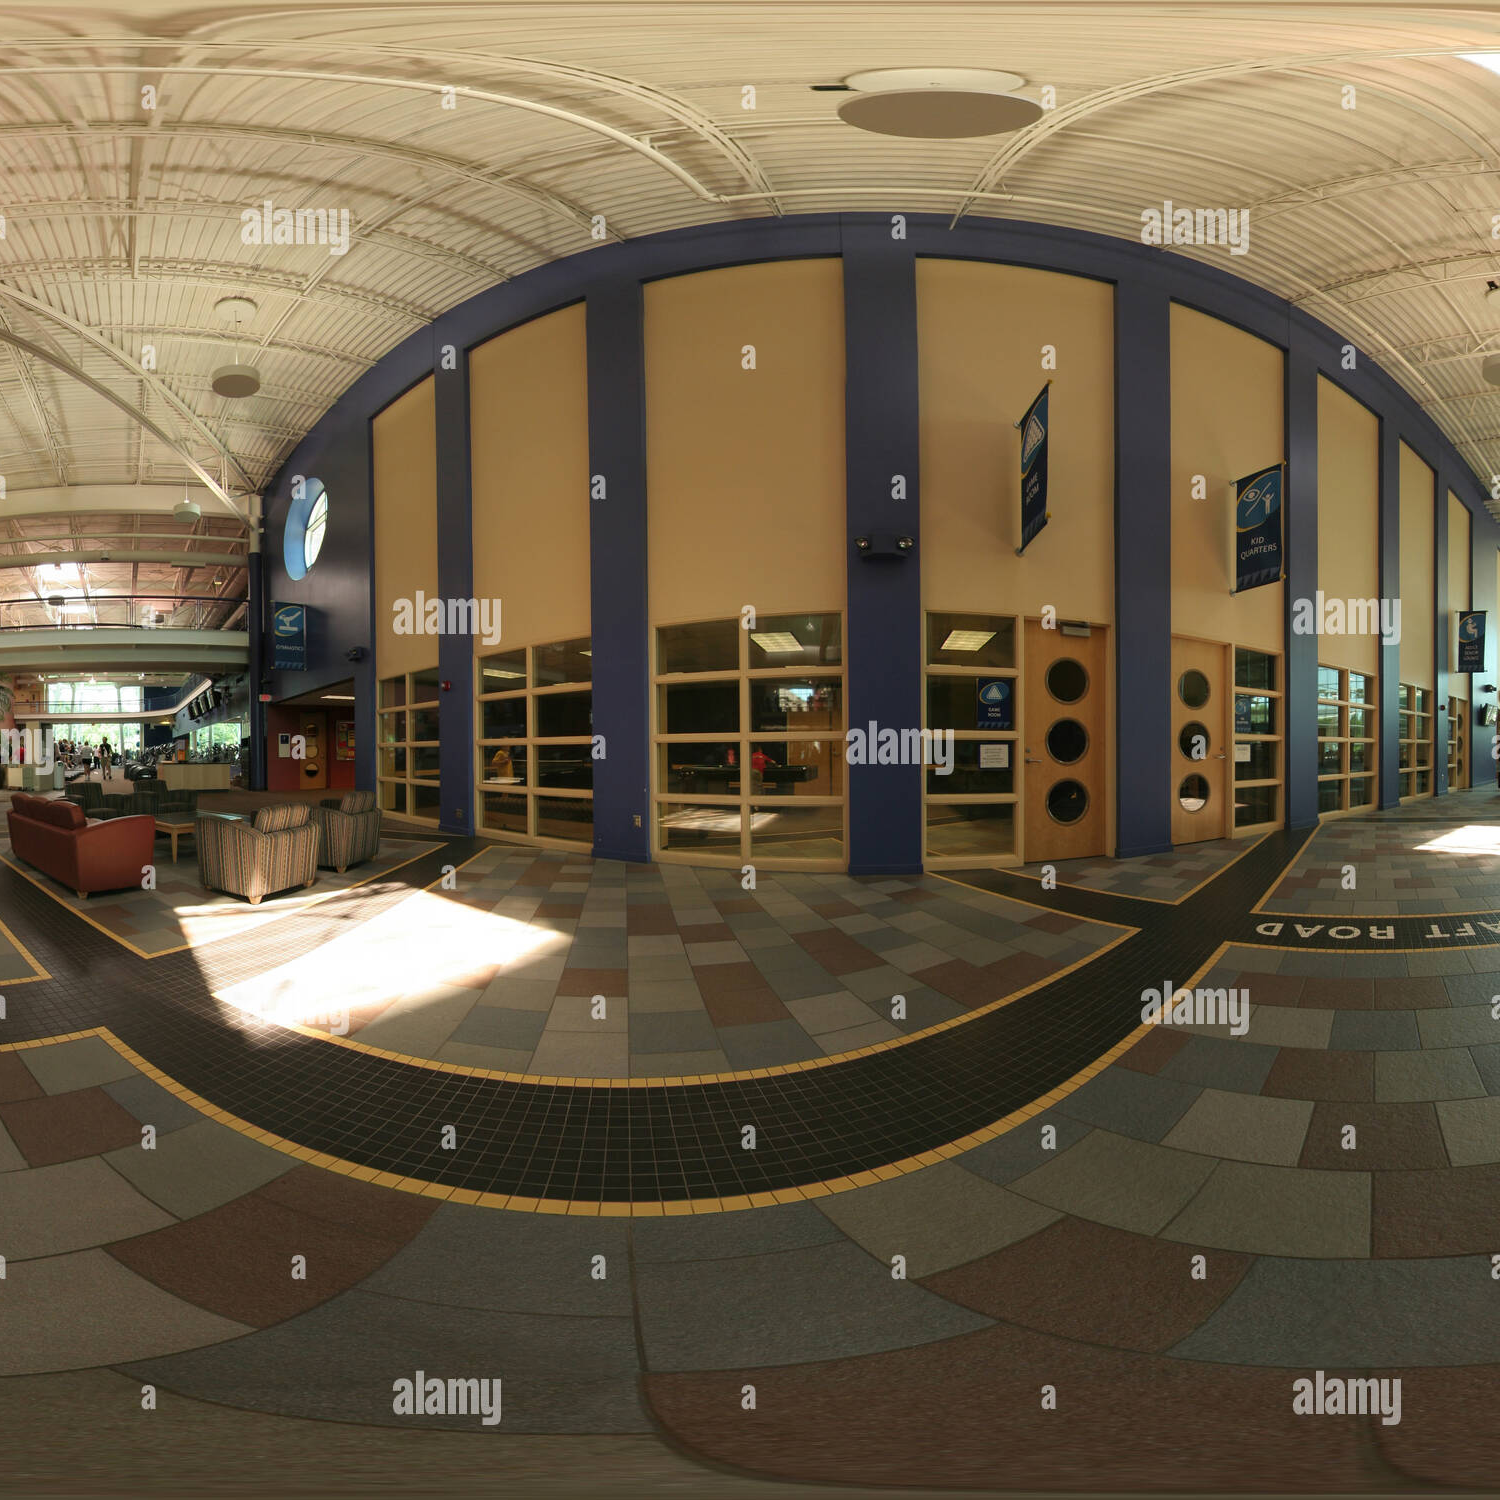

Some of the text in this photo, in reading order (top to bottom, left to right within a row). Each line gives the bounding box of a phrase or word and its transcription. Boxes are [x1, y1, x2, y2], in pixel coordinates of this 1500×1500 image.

[1251, 536, 1265, 545] KID
[1240, 543, 1277, 560] QUARTERS
[1255, 922, 1396, 940] ROAD
